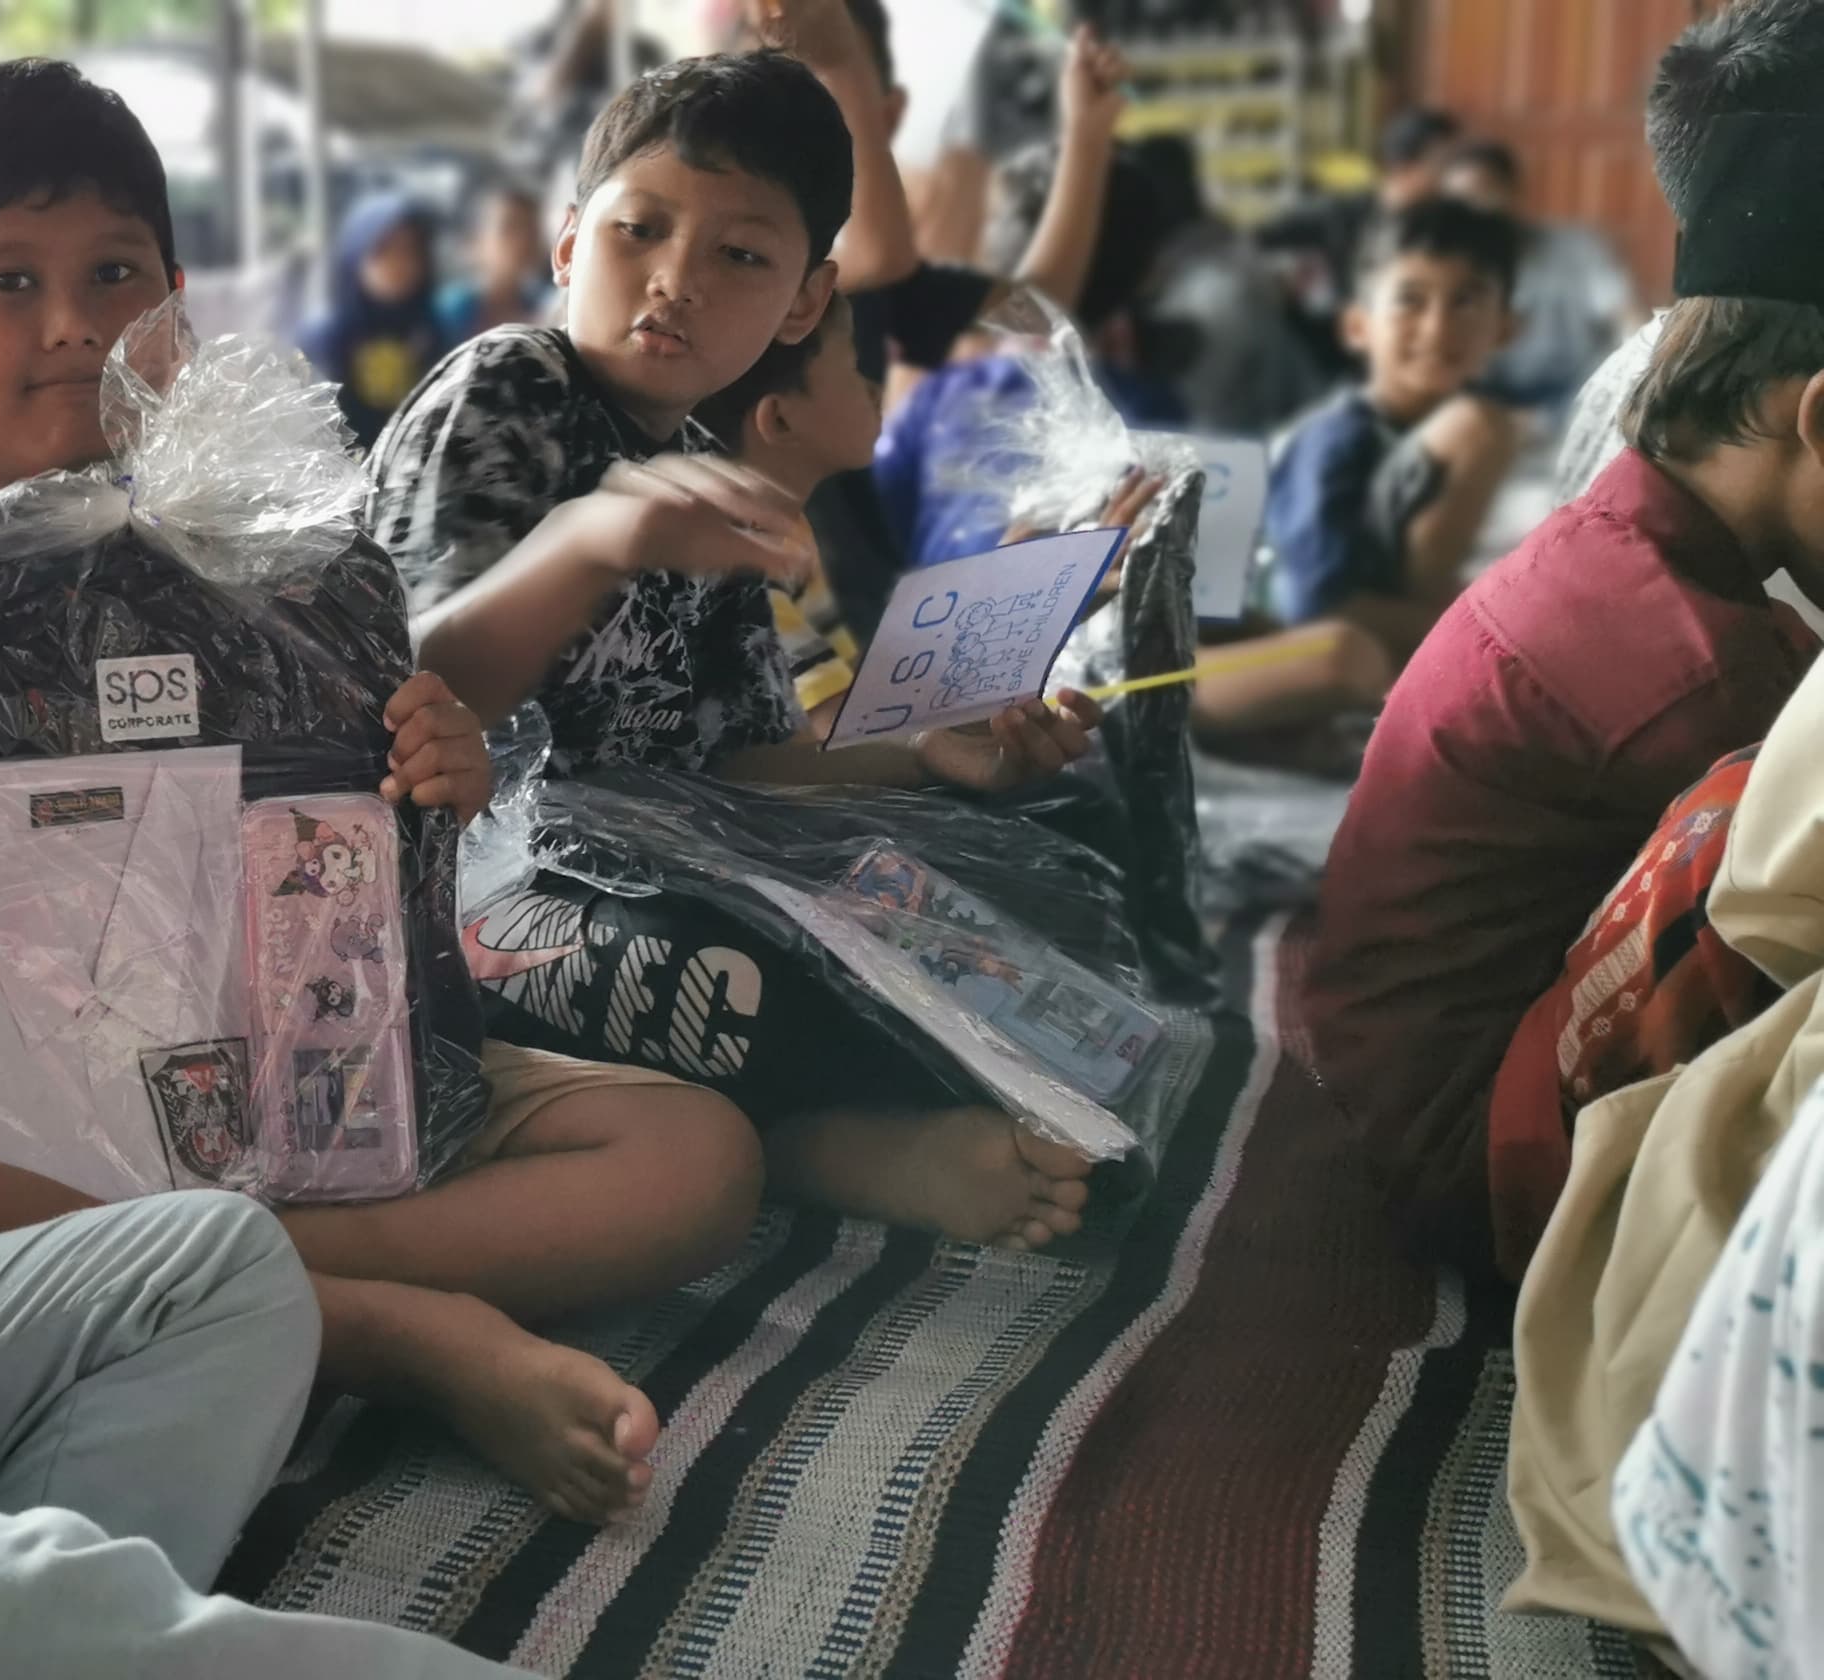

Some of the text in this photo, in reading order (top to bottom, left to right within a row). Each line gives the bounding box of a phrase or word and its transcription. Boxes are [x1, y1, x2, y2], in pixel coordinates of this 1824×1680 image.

[1025, 563, 1076, 643] CHILDREN
[106, 667, 189, 712] sps
[108, 713, 191, 729] CORPORATE
